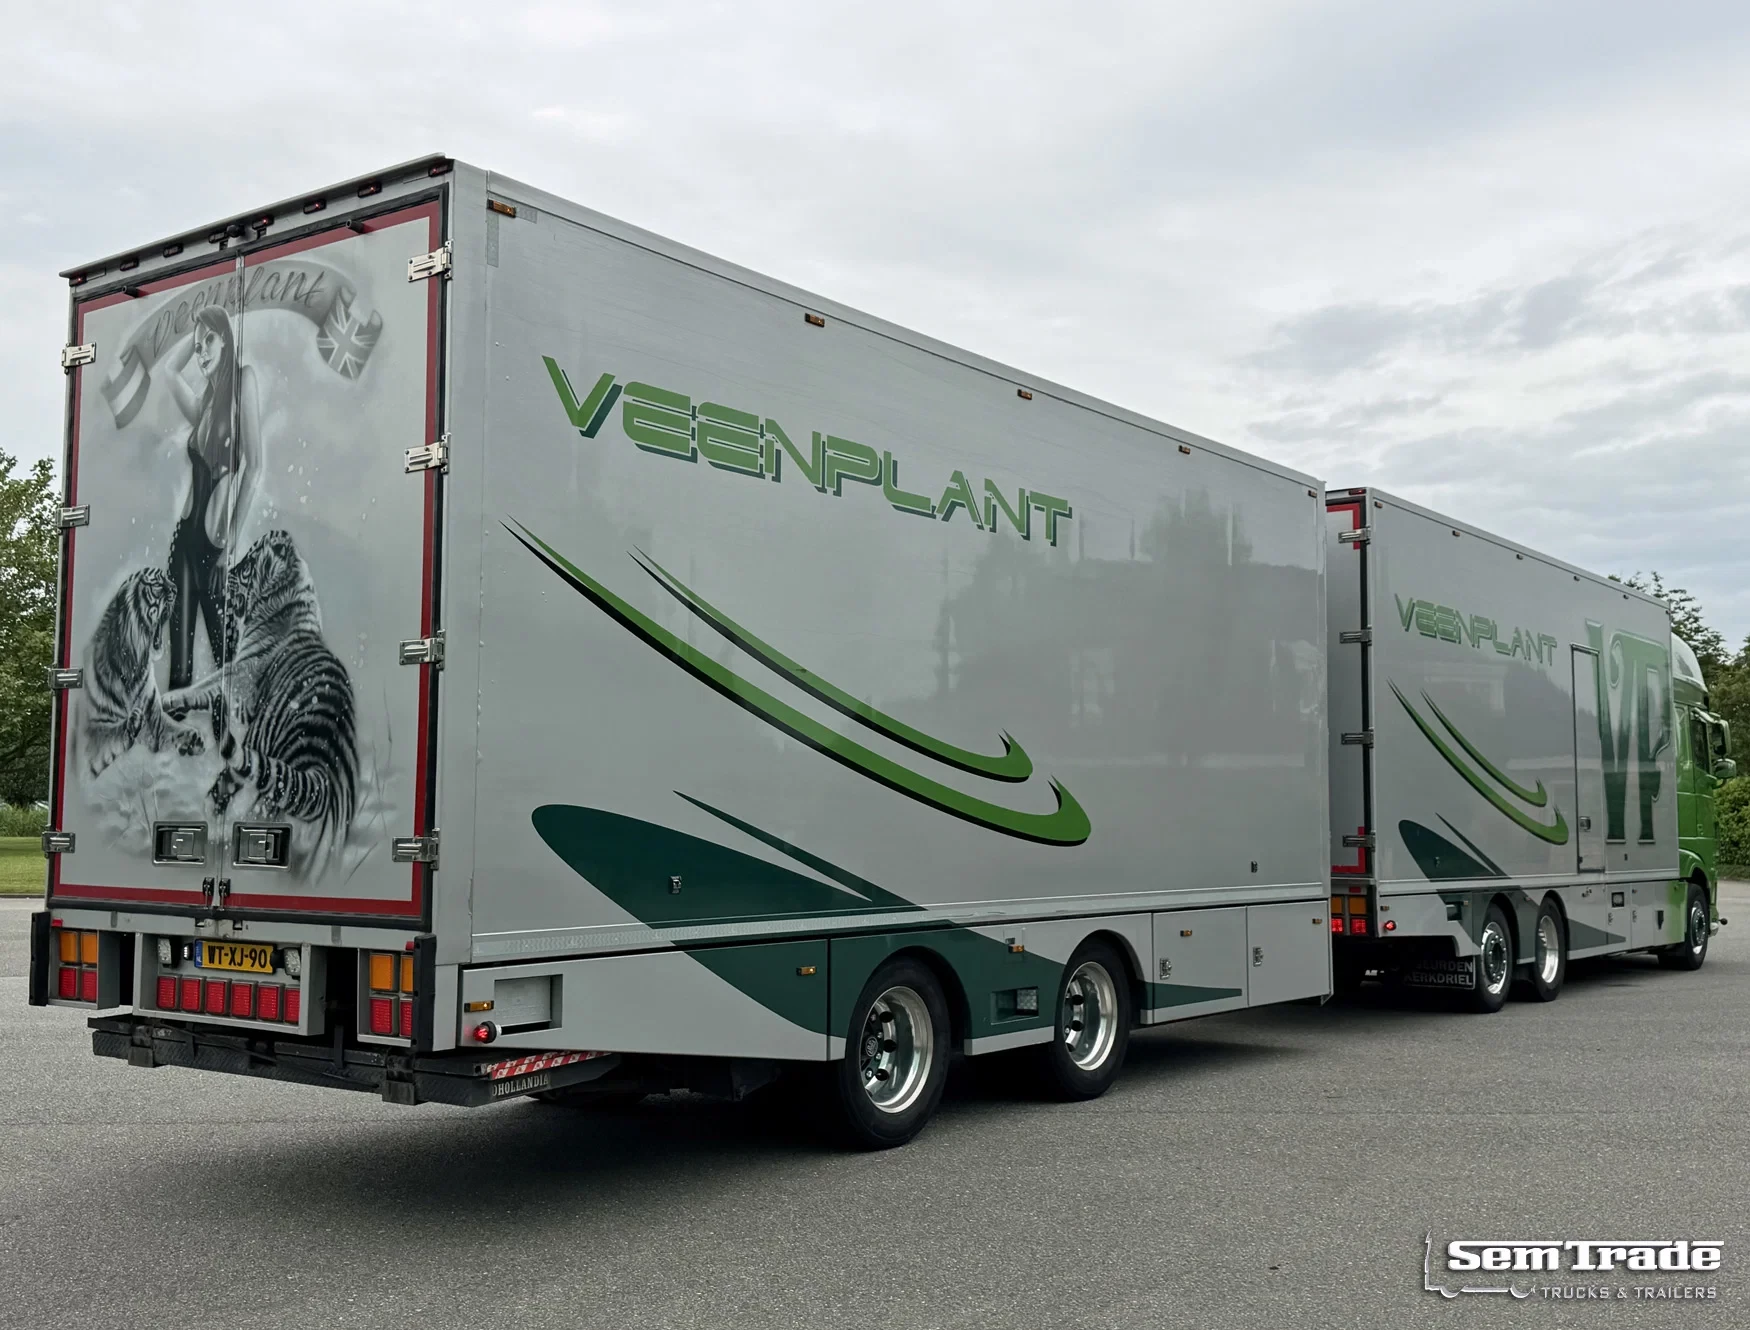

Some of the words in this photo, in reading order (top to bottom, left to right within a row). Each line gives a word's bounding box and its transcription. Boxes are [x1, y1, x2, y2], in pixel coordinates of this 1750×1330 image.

[542, 355, 1073, 547] VEENPLANT
[1396, 593, 1557, 666] VEENPLANT
[208, 946, 267, 968] WT-XJ-90
